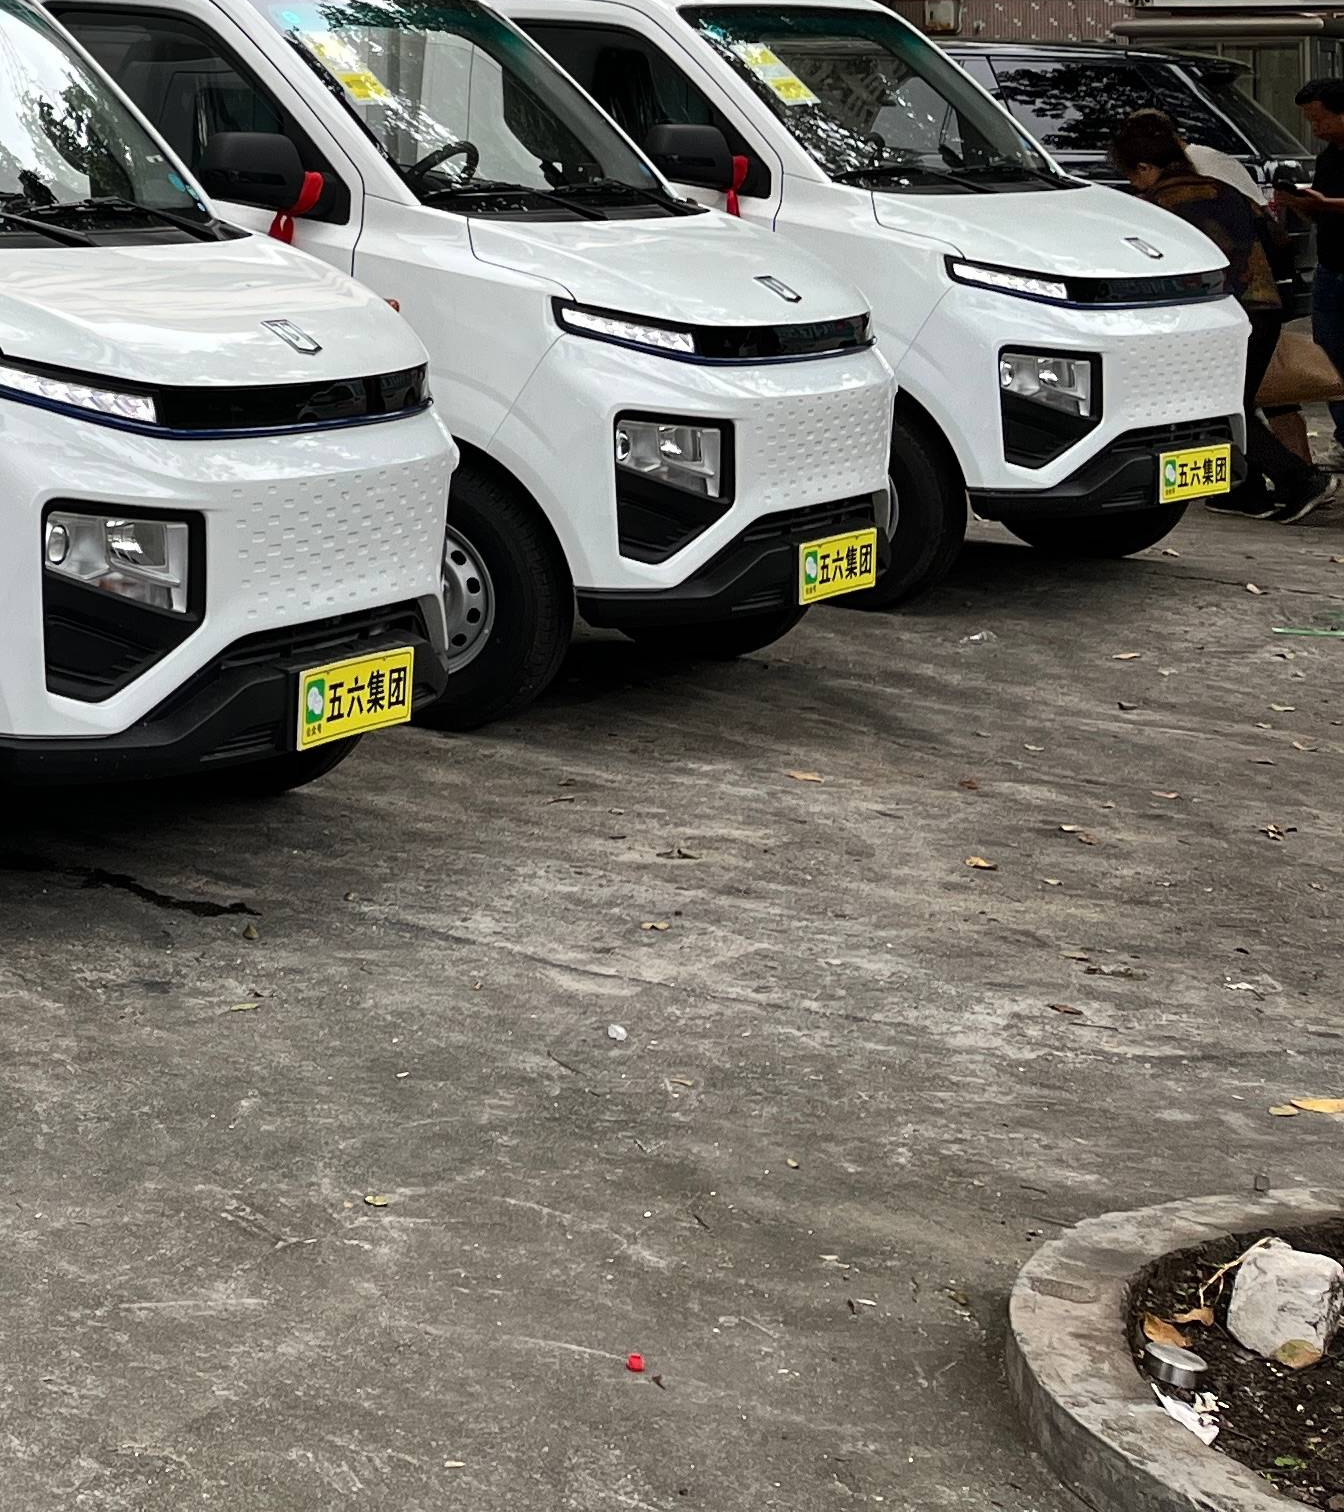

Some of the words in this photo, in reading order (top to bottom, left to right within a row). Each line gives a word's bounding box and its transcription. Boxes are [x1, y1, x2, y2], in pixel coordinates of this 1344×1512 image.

[1177, 457, 1227, 488] 五六集团
[819, 543, 873, 584] 五六集团
[326, 666, 408, 723] 五六集团
